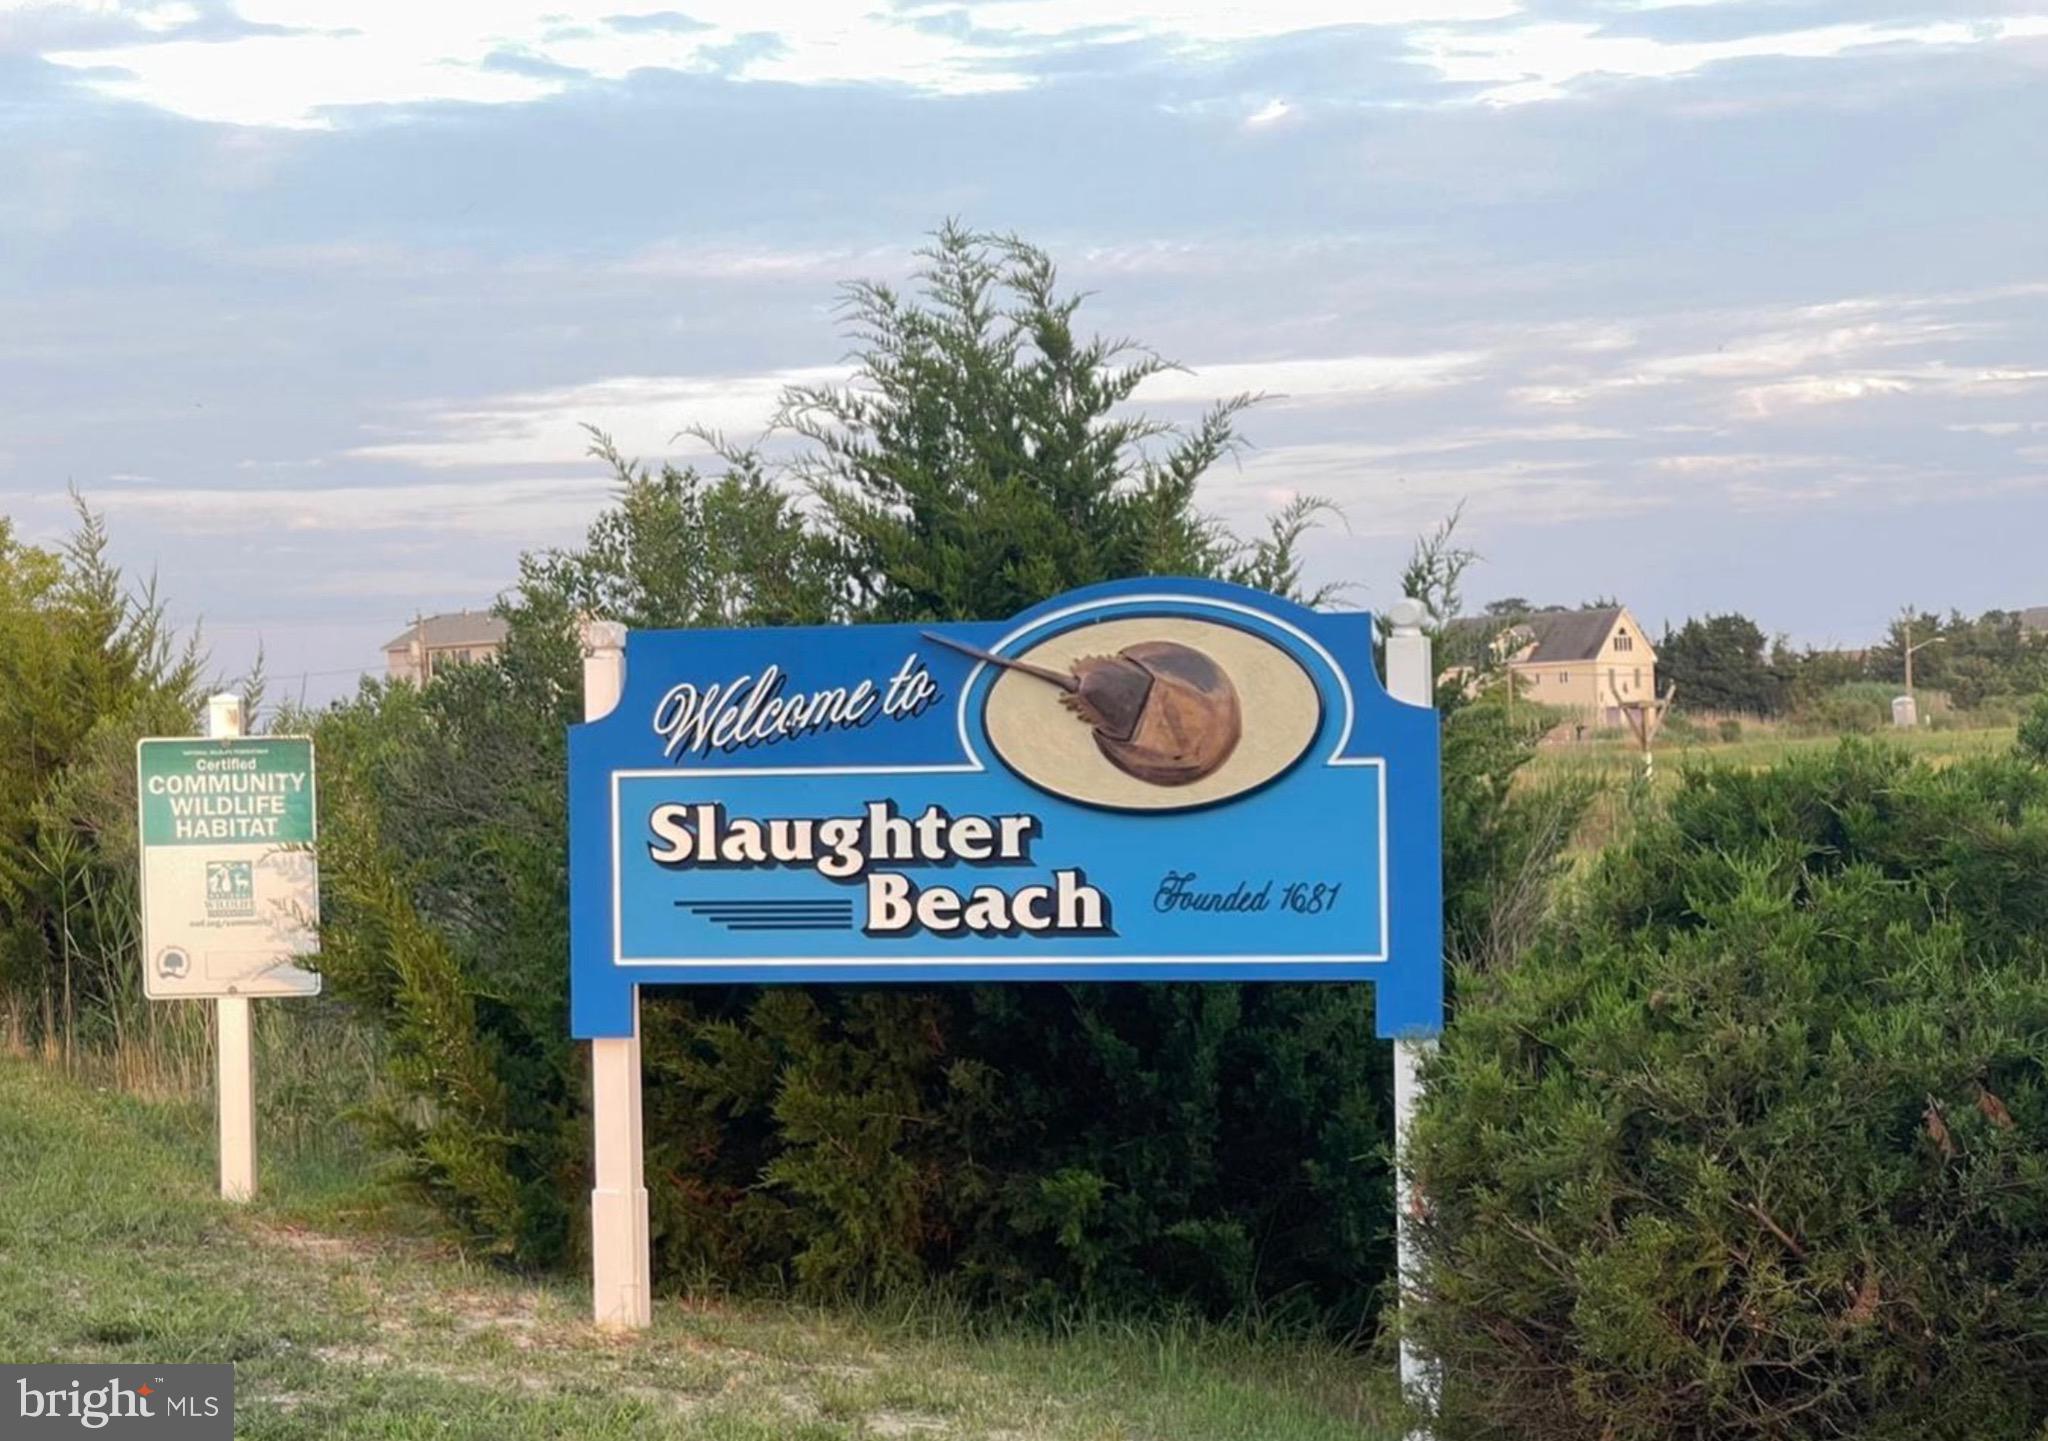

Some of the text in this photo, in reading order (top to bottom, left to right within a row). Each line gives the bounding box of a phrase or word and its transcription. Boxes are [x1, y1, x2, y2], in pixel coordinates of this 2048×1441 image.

[653, 652, 937, 758] Welcome to
[196, 757, 257, 771] Certified
[148, 771, 306, 795] COMMUNITY
[170, 795, 286, 816] WILDLIFE
[176, 817, 279, 839] HABITAT
[648, 800, 1036, 878] Slaughter
[865, 868, 1108, 936] Beach
[1153, 870, 1342, 915] Founded 1681
